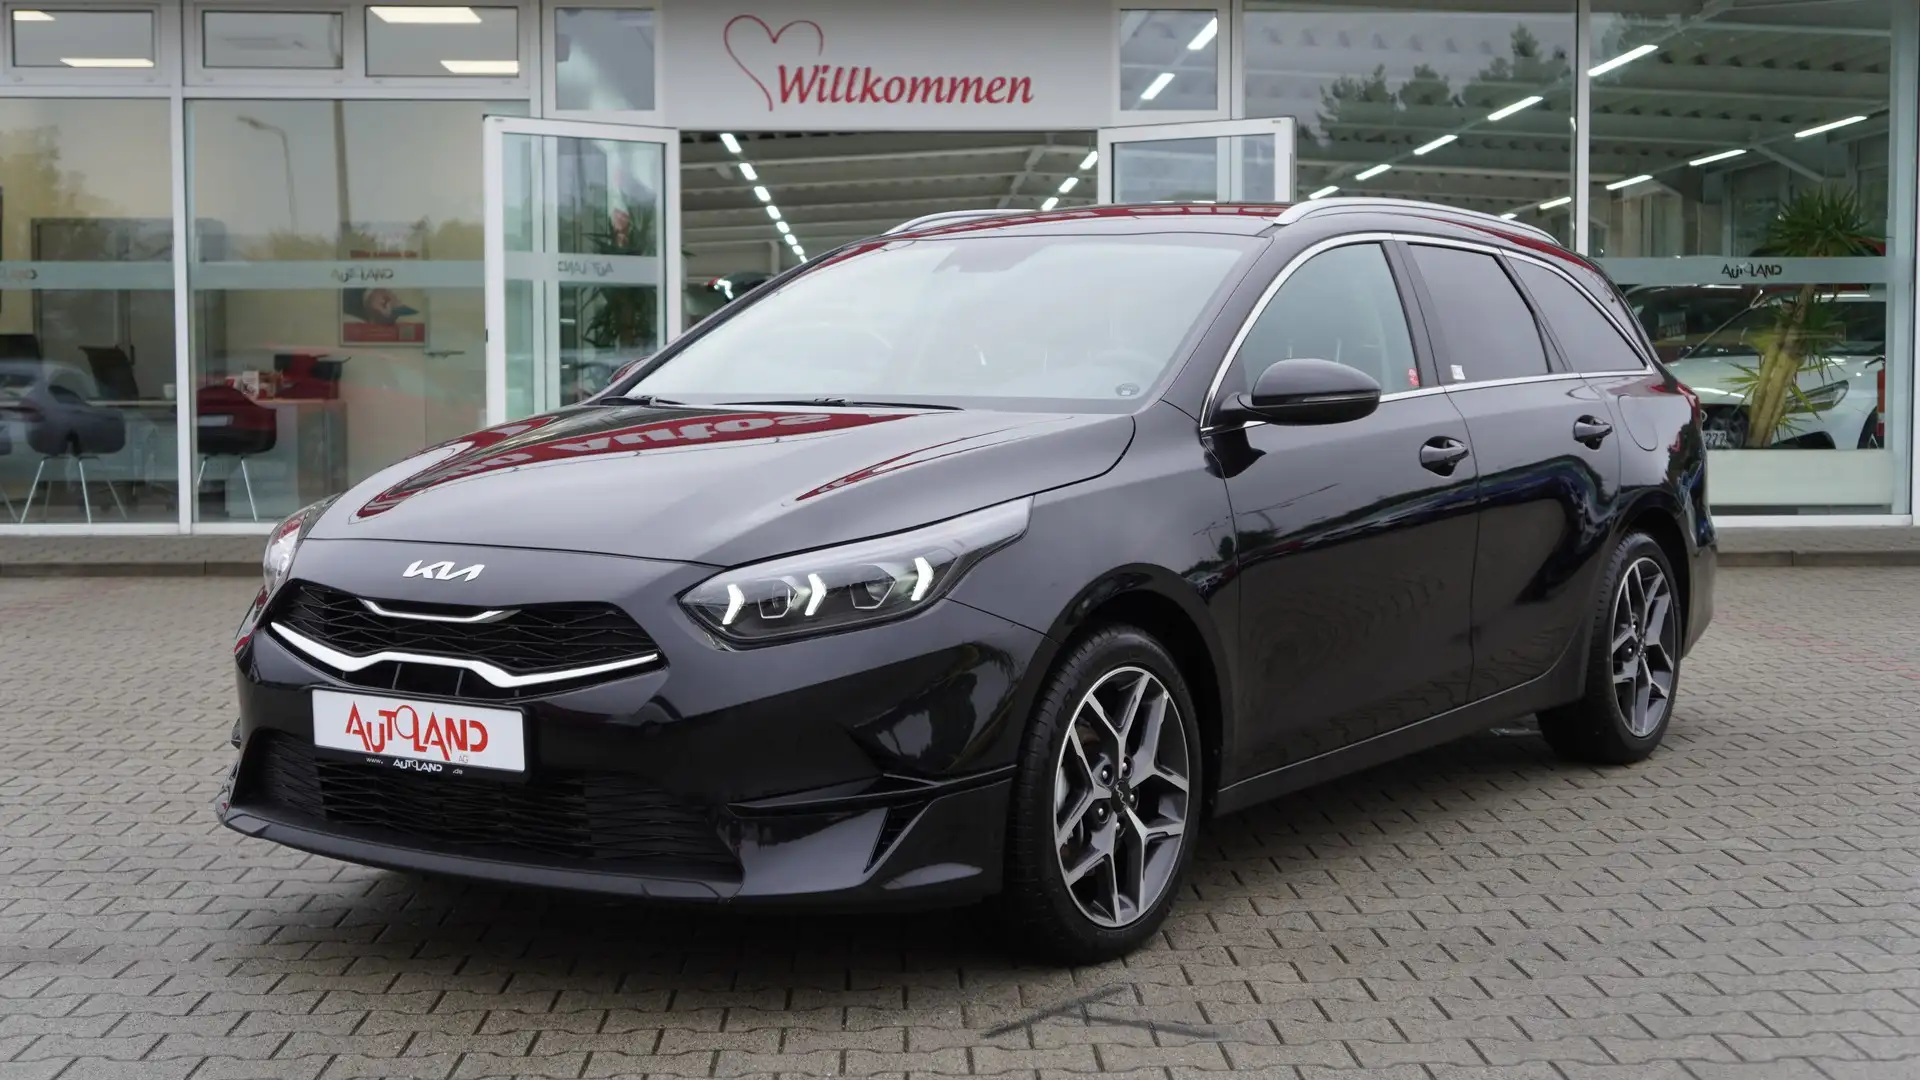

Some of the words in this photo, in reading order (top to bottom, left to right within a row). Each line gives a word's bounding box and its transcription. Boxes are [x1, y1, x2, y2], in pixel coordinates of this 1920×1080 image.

[777, 64, 1034, 104] Willkommen
[403, 560, 485, 582] KIA
[345, 702, 489, 761] AUTOLAND
